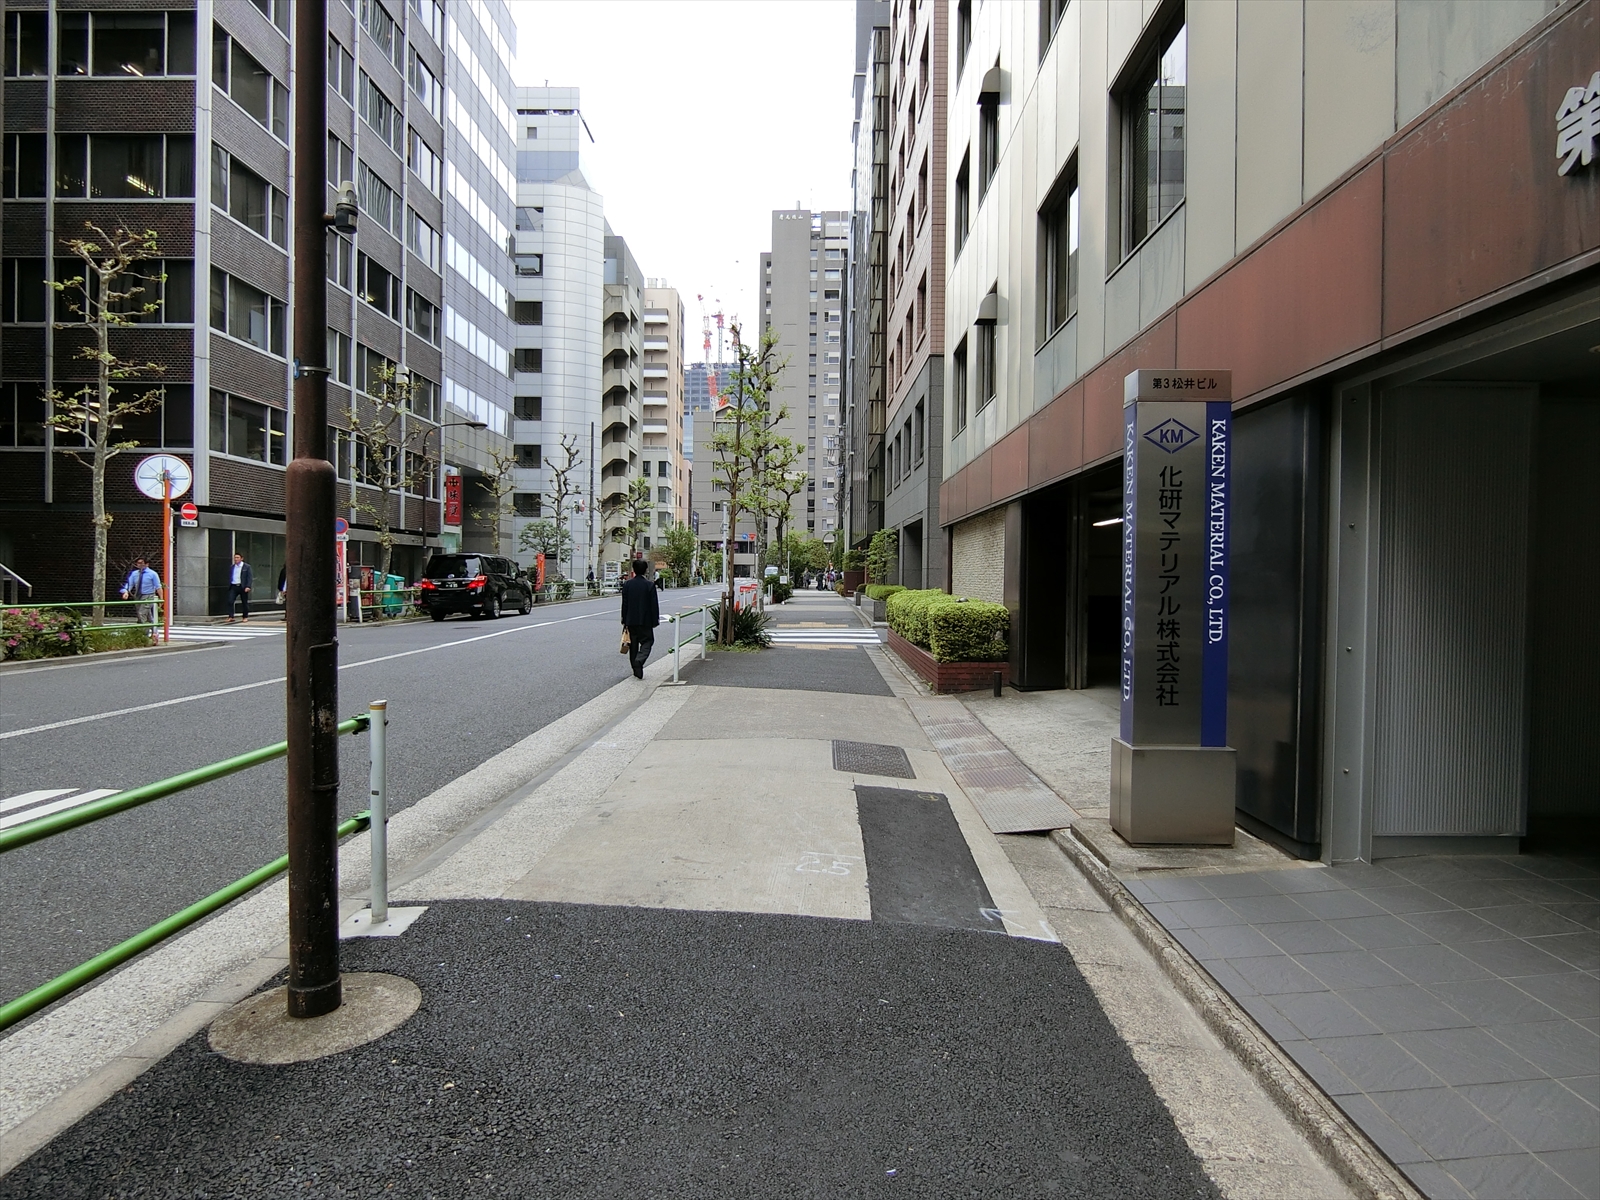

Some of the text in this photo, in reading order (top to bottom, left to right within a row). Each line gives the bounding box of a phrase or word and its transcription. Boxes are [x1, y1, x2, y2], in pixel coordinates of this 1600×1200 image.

[1152, 377, 1218, 390] 第3松井ビル
[1126, 421, 1134, 495] KAKEN
[1159, 428, 1184, 444] KM
[1210, 419, 1226, 479] KAKEN
[1124, 501, 1133, 612] MATERIAL
[1209, 482, 1225, 571] MATERIAL
[1156, 465, 1182, 707] 化研マテリアル株式会社
[1208, 608, 1223, 645] LTD.
[1122, 657, 1131, 702] LTD.
